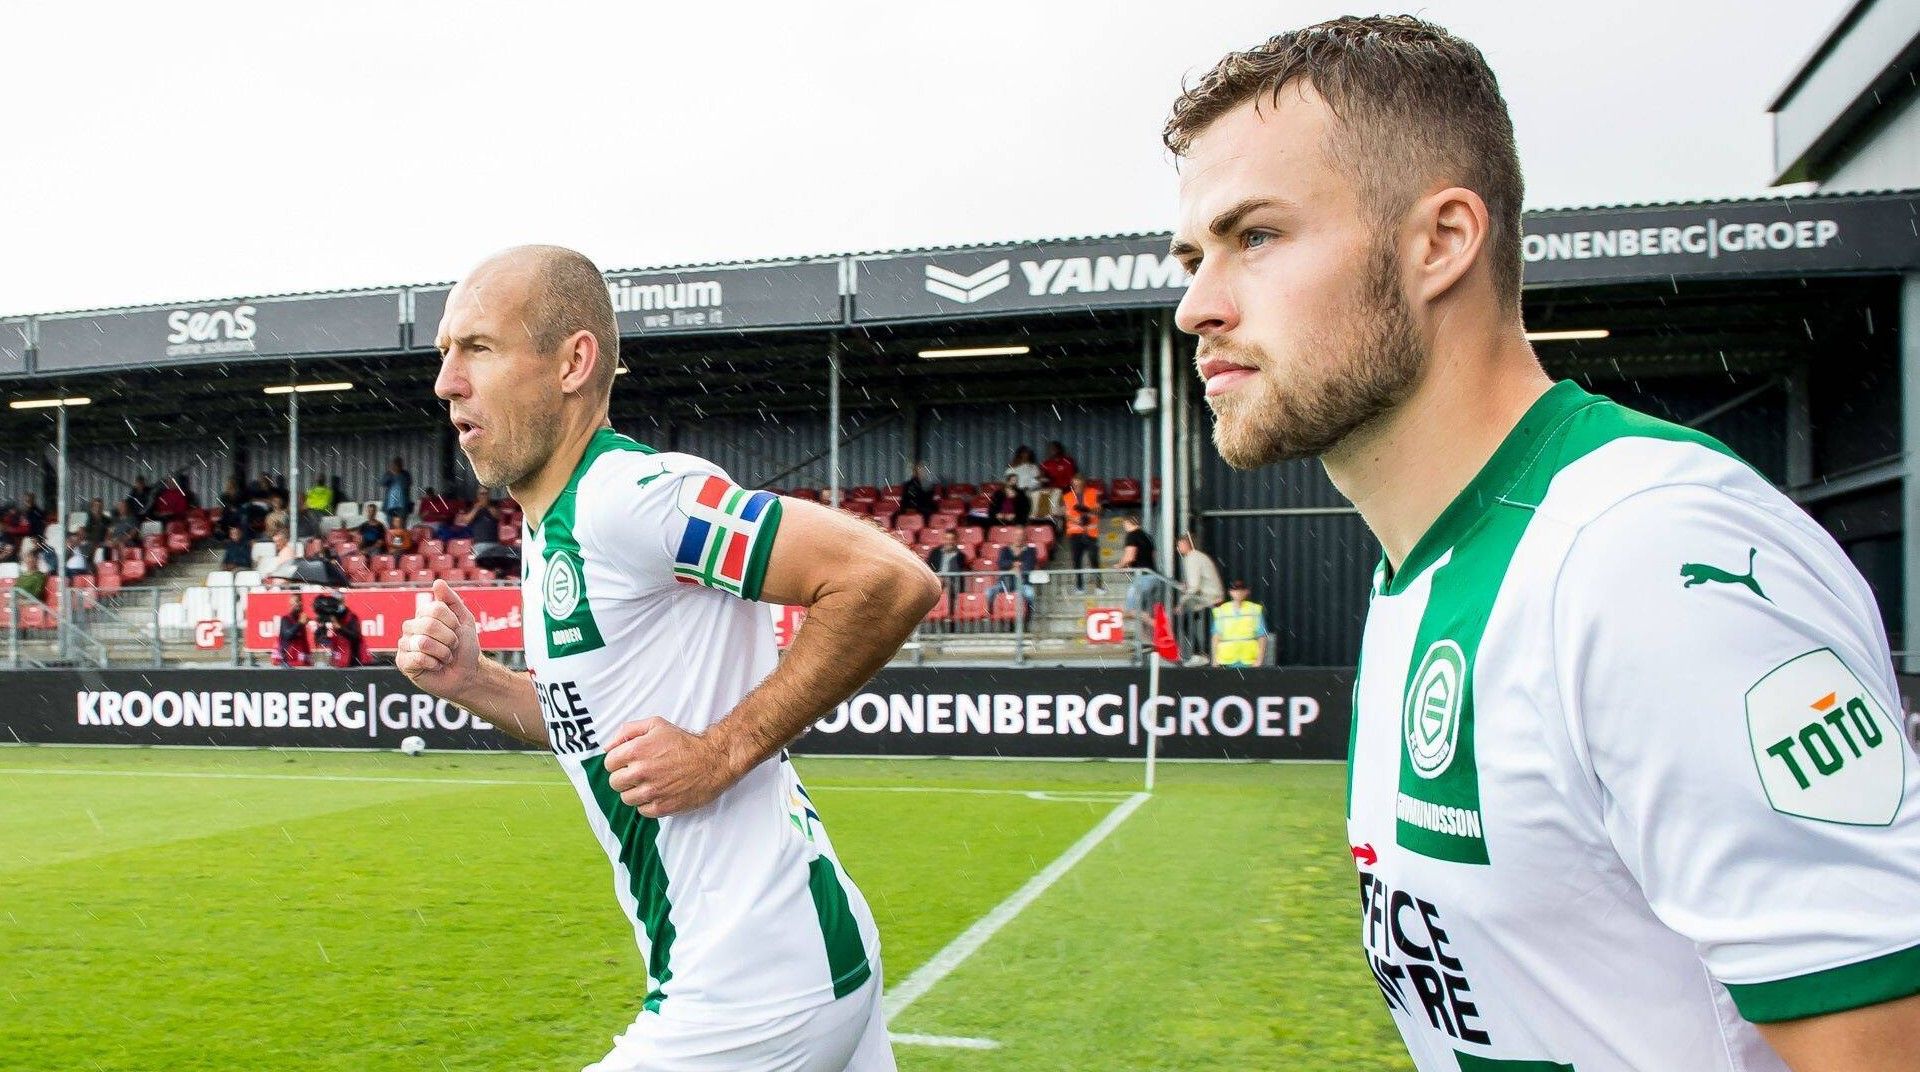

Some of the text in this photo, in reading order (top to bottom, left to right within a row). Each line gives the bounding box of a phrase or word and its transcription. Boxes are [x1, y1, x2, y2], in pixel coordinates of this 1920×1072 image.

[1522, 219, 1839, 263] ONENBERG GROEP
[609, 278, 722, 313] timum
[76, 690, 494, 730] KROONENBERG GRO
[803, 692, 1320, 737] OONENBERG GROEP
[1766, 696, 1883, 791] TOTO
[1397, 791, 1482, 839] MUNDSSON
[1359, 871, 1464, 973] FFICE
